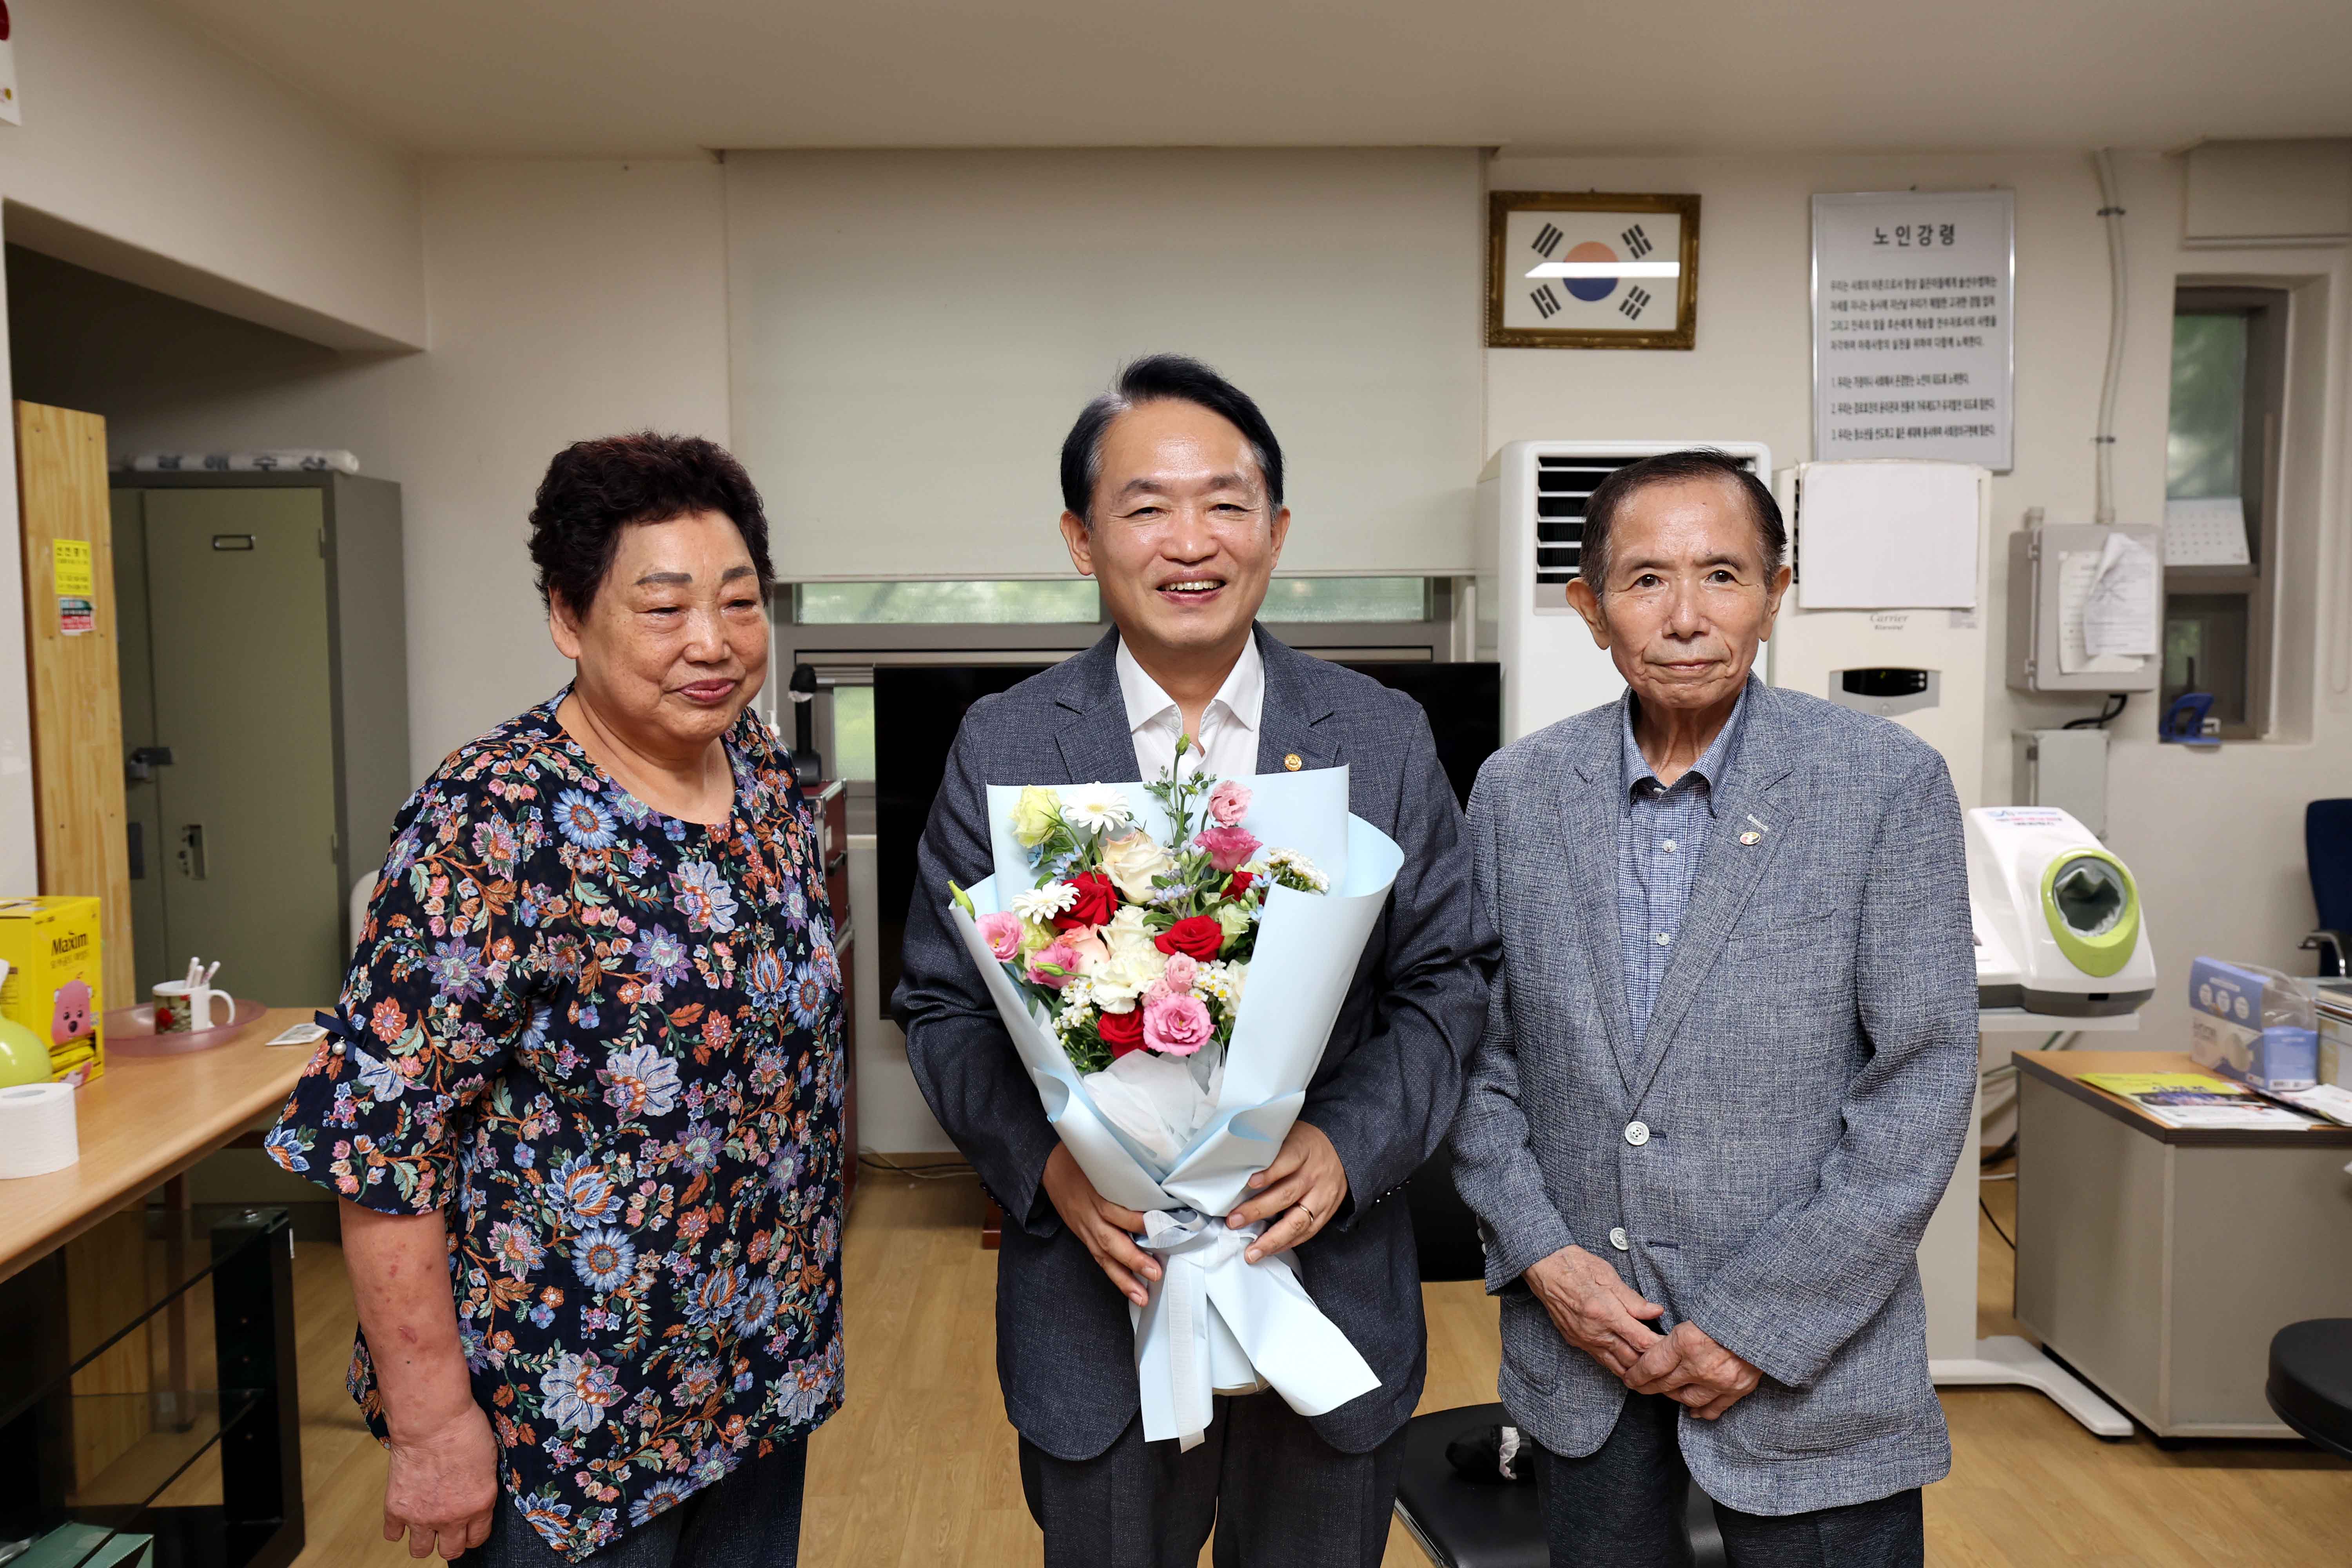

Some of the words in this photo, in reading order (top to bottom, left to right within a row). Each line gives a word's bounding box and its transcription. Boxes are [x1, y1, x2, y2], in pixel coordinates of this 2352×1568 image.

[1873, 223, 1955, 246] 노인강령
[1869, 614, 1908, 622] Carrier
[51, 930, 88, 956] Maxim
